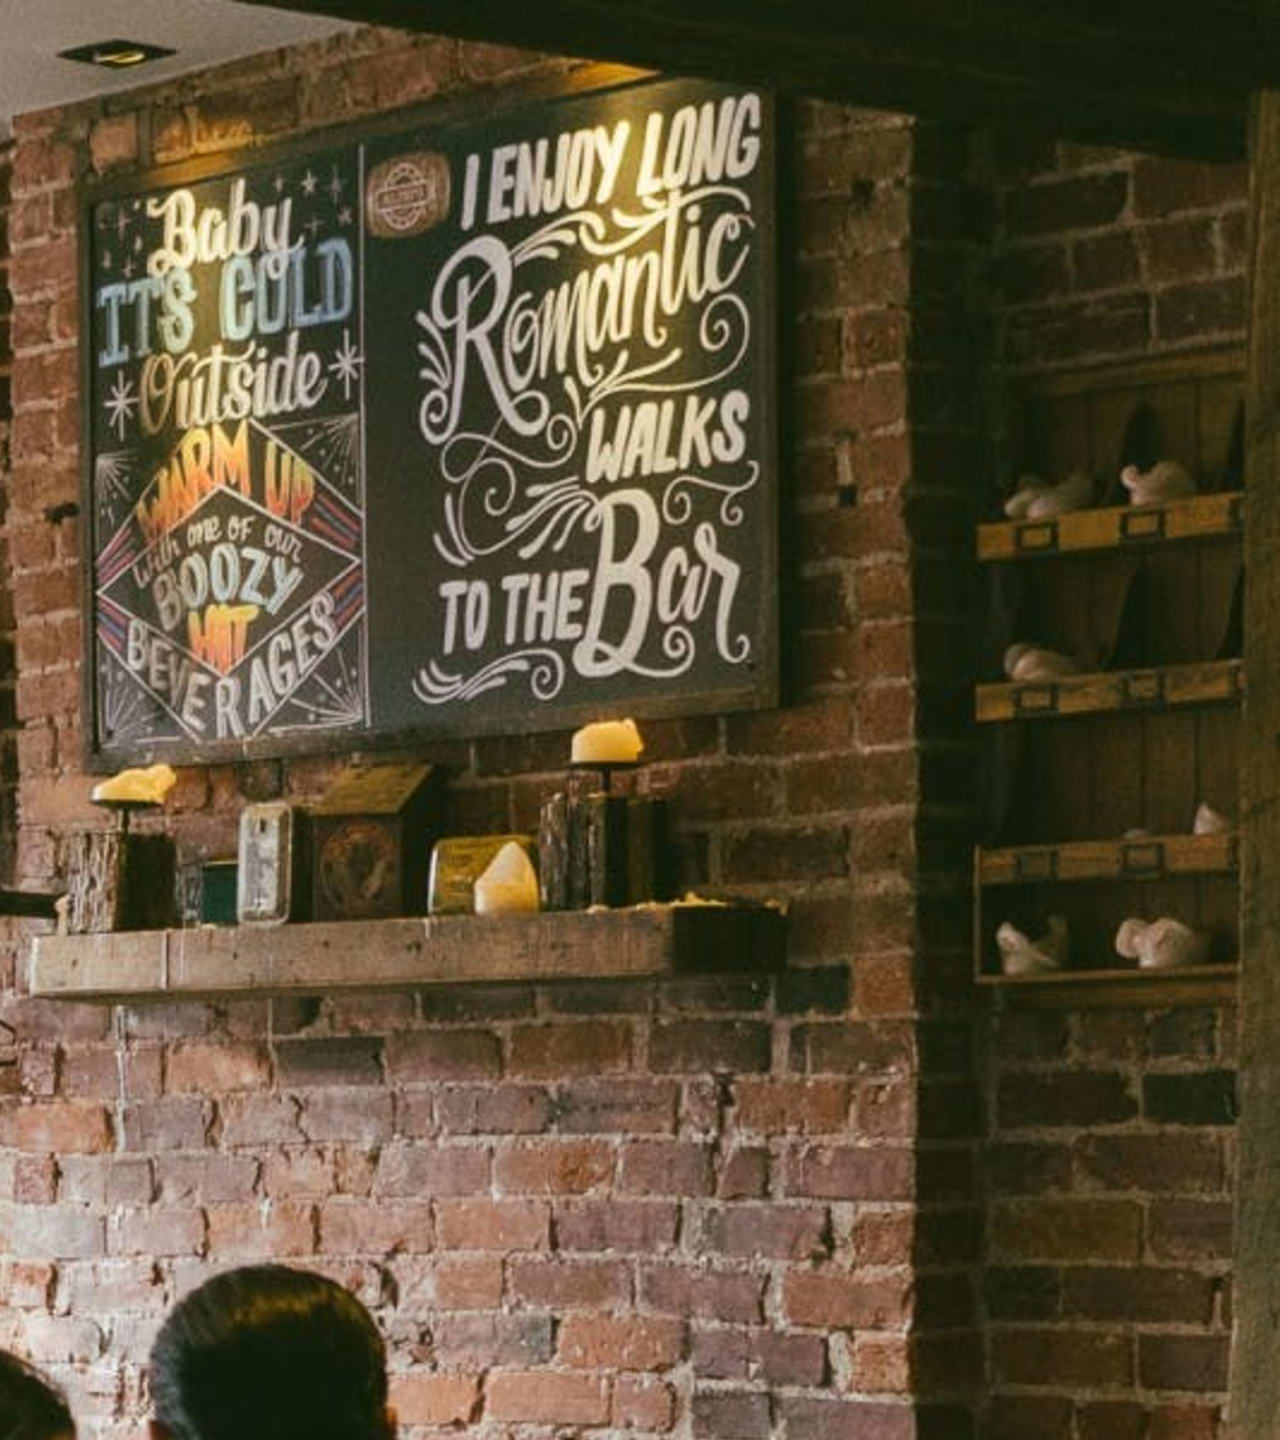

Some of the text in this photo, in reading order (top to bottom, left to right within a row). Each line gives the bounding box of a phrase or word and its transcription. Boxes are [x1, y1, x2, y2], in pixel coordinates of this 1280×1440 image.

[460, 154, 480, 231] I
[486, 119, 631, 225] ENJOY
[636, 93, 761, 198] LONG
[147, 178, 304, 280] Baby
[219, 238, 353, 341] COLD
[430, 190, 754, 438] Romantic
[141, 330, 328, 434] Outside
[586, 390, 749, 483] WALKS
[137, 422, 315, 541] WARM UP
[153, 542, 304, 631] BOOZY
[440, 488, 751, 677] TO THE Bar
[127, 592, 338, 738] BEVERAGES
